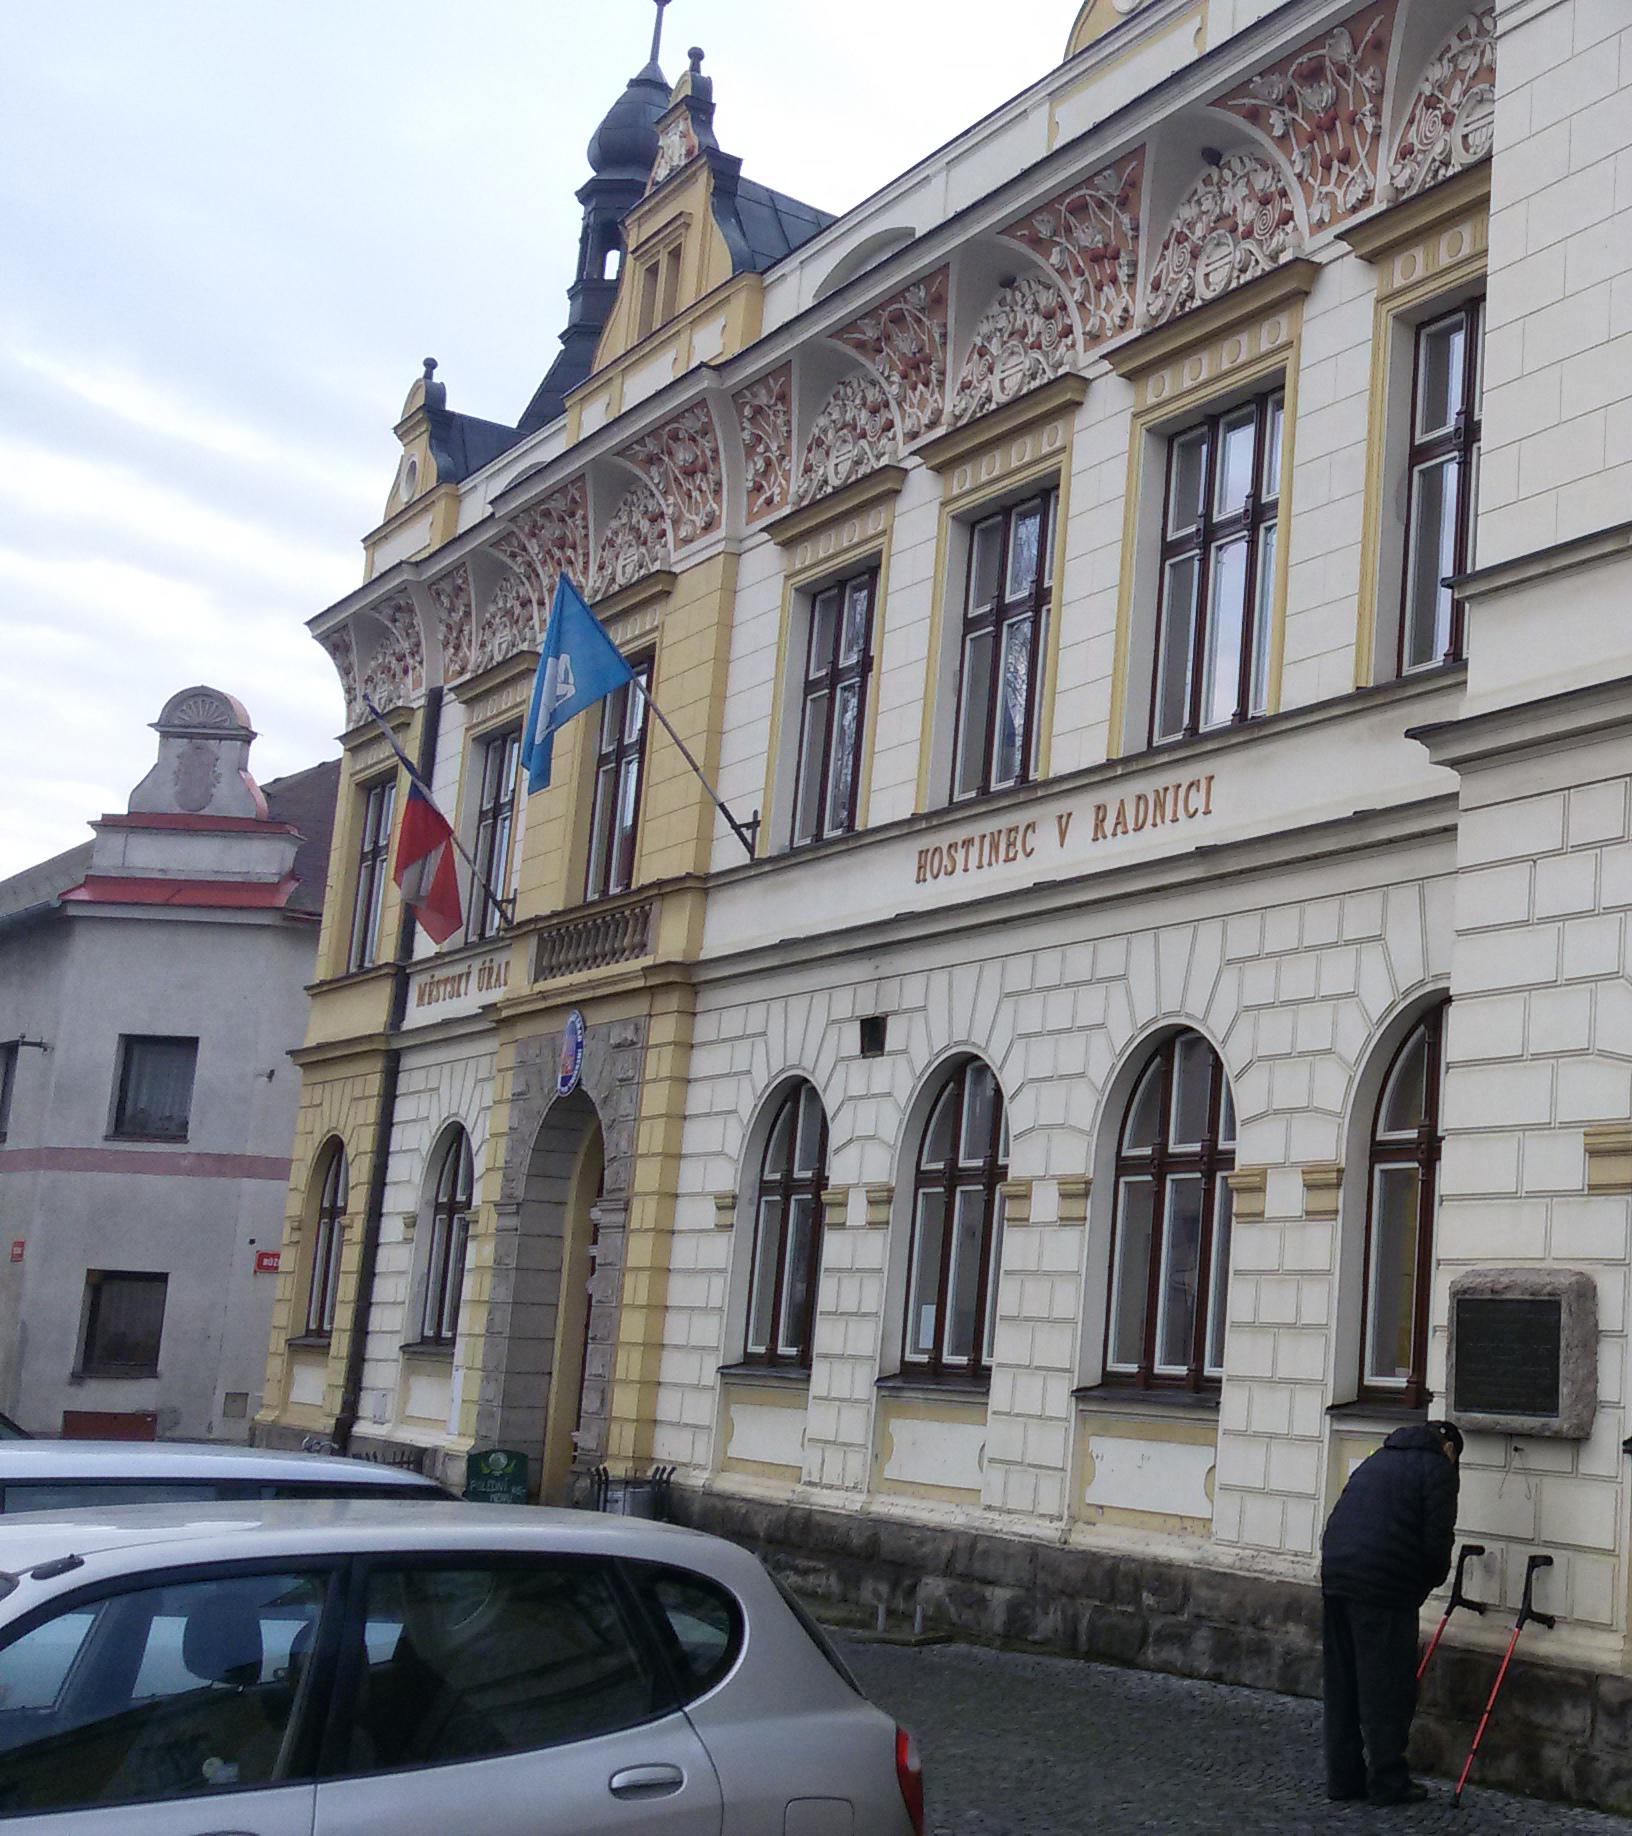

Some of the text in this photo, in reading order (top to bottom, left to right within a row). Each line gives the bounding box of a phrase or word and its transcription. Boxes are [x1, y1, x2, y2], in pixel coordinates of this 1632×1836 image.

[915, 774, 1215, 884] HOSTINEC V RADNICI
[416, 963, 472, 1008] MĚSTSKÝ
